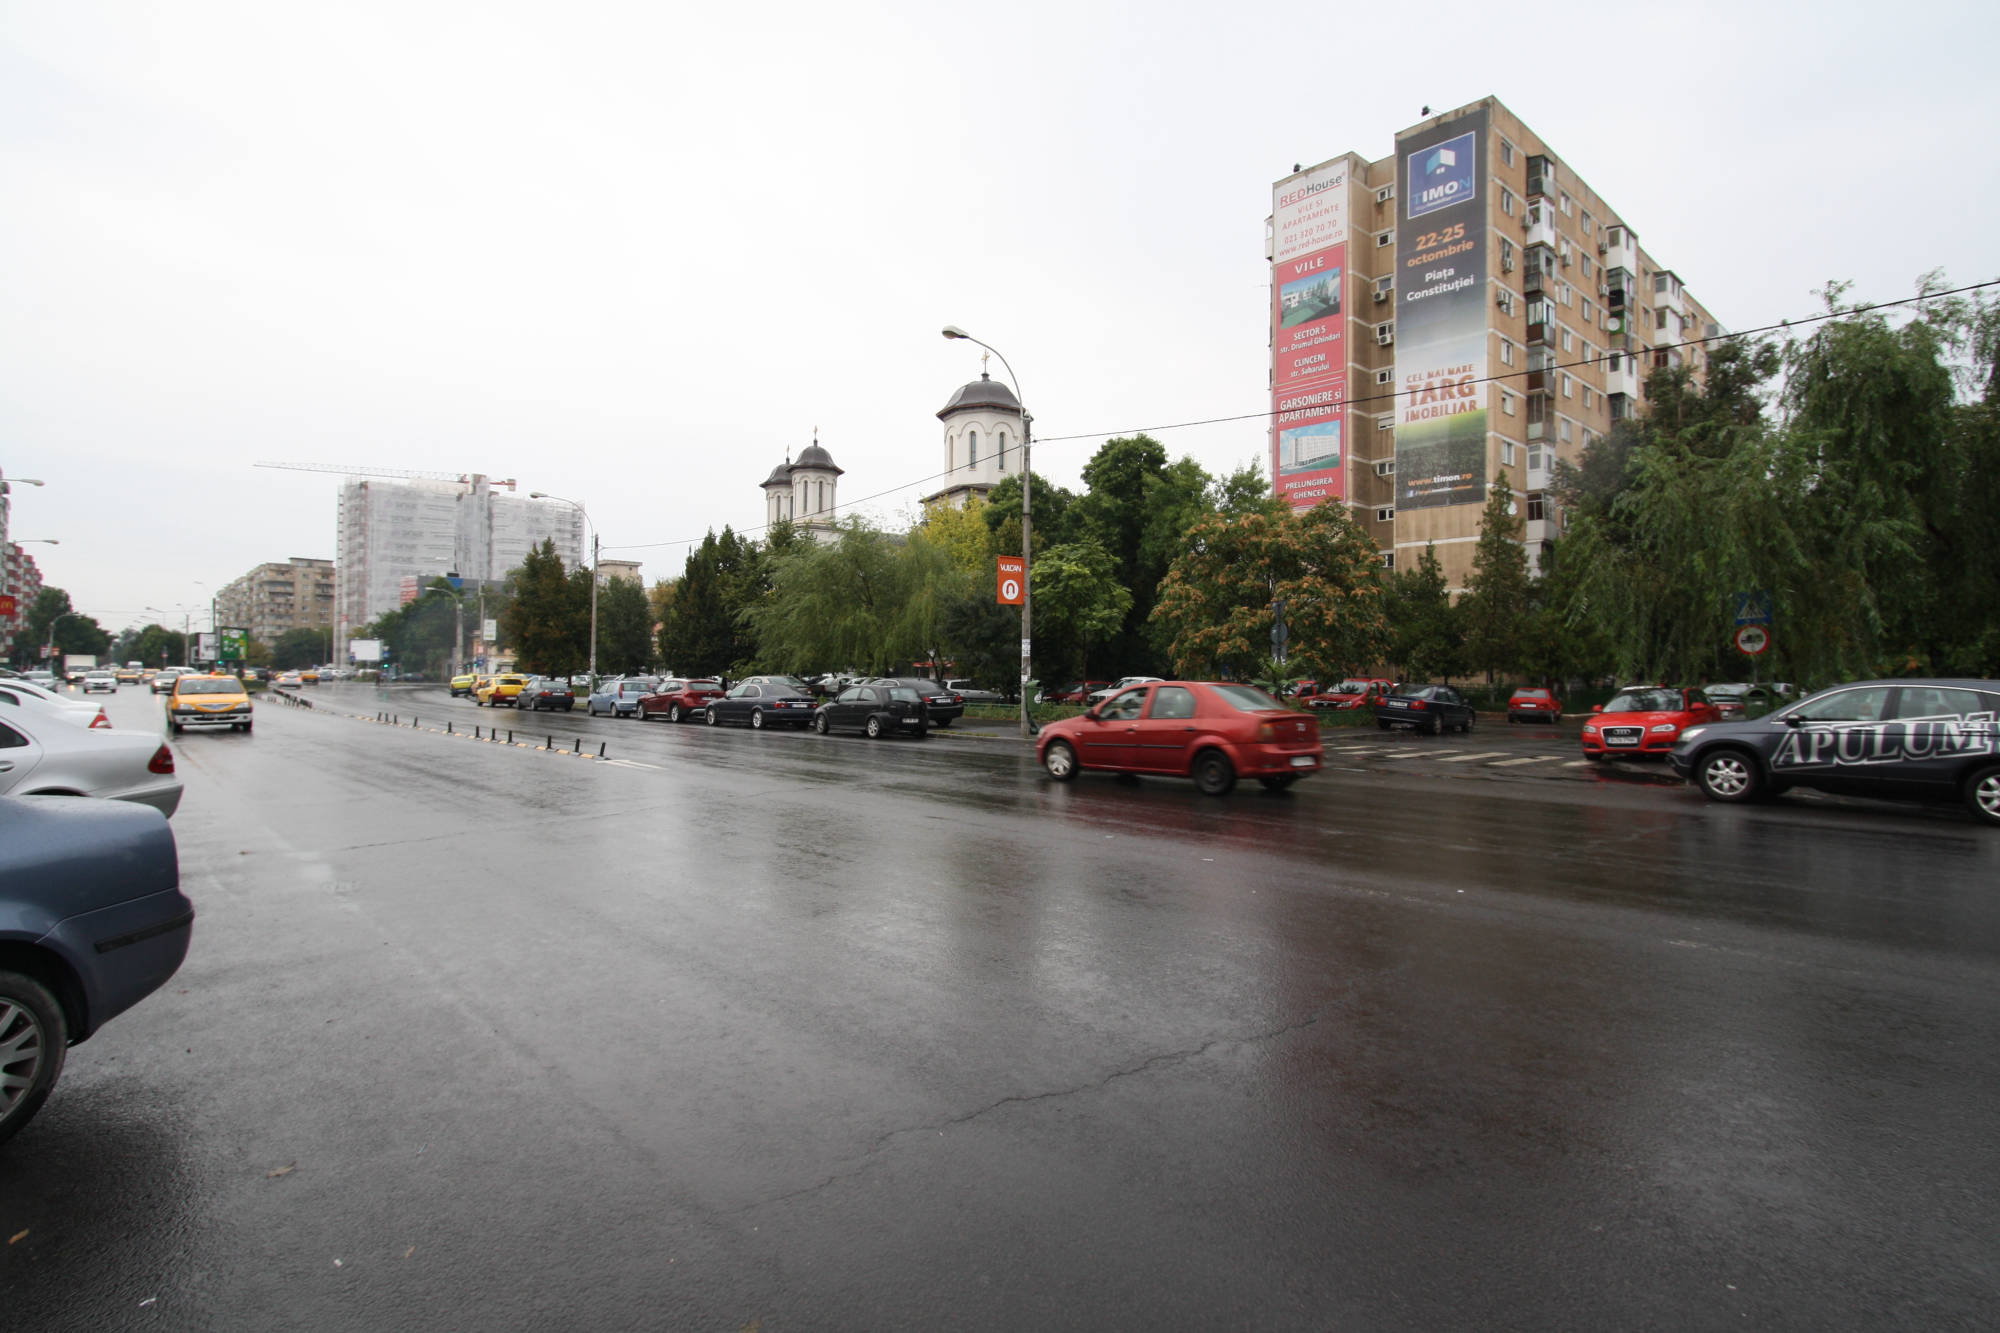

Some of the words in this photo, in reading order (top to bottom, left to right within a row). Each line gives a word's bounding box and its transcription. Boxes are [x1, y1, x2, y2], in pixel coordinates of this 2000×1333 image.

[1411, 176, 1471, 205] TIMON
[1415, 222, 1465, 251] 22-25
[1407, 240, 1474, 267] octombrie
[1295, 256, 1324, 274] VILE
[1294, 327, 1320, 341] SECTOR
[1407, 373, 1424, 384] CEL
[1427, 368, 1445, 379] MAI
[1447, 364, 1473, 375] MARE
[1280, 390, 1333, 411] GARSONIERE
[1406, 375, 1475, 408] TARG
[1279, 404, 1341, 424] APARTAMENTE
[1405, 400, 1477, 423] IMOBILIAR
[1285, 477, 1333, 490] PRELUNGIREA
[1293, 490, 1326, 499] GHENCEA
[1777, 718, 1988, 765] APULUM
